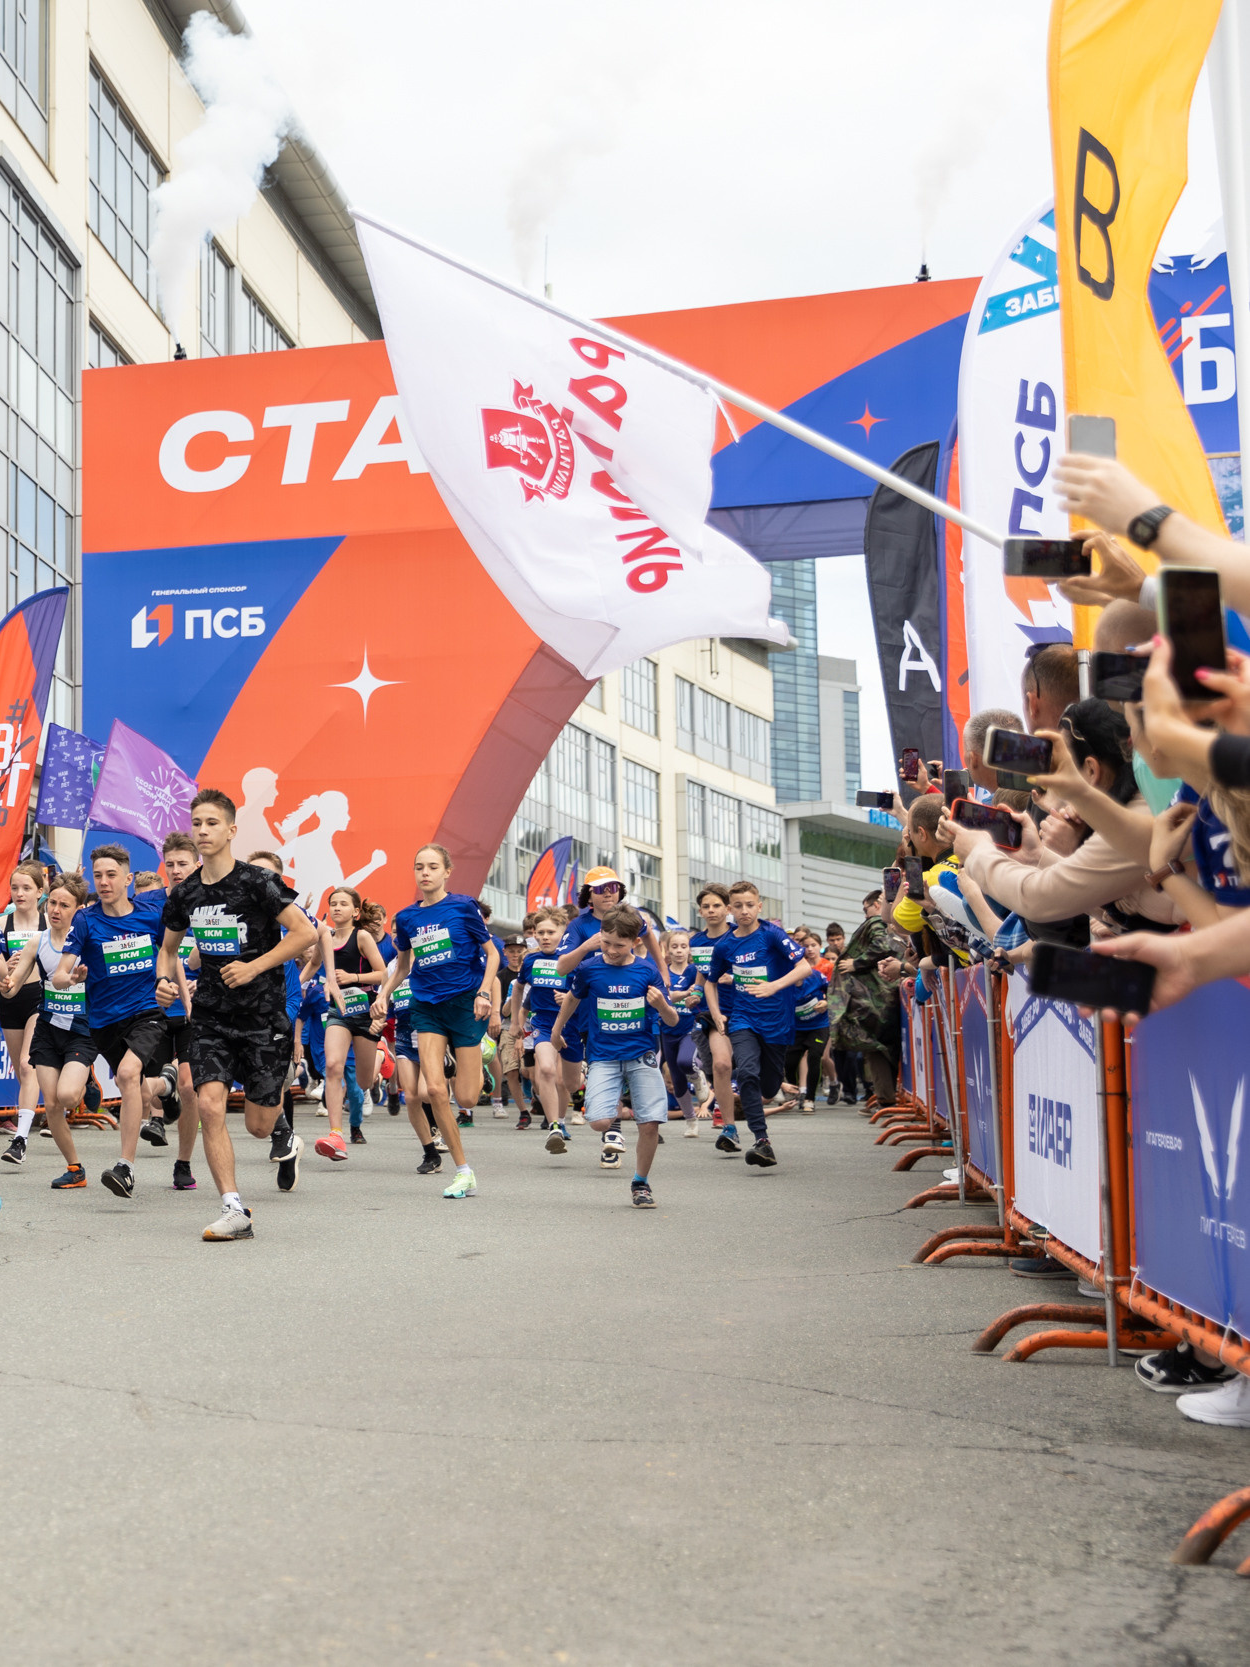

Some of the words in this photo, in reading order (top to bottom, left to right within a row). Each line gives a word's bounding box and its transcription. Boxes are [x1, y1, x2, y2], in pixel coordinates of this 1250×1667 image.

[1009, 378, 1057, 538] ПСБ
[151, 586, 208, 597] ГЕНЕРАЛЬНЫЙ
[209, 585, 247, 594] СПОНСОР
[185, 606, 266, 640] ПСБ
[199, 942, 235, 952] 20132
[418, 951, 451, 967] 20337
[109, 959, 153, 974] 20492
[533, 977, 562, 986] 20176
[47, 1002, 82, 1012] 20162
[395, 999, 410, 1009] 202
[601, 1021, 641, 1031] 20341
